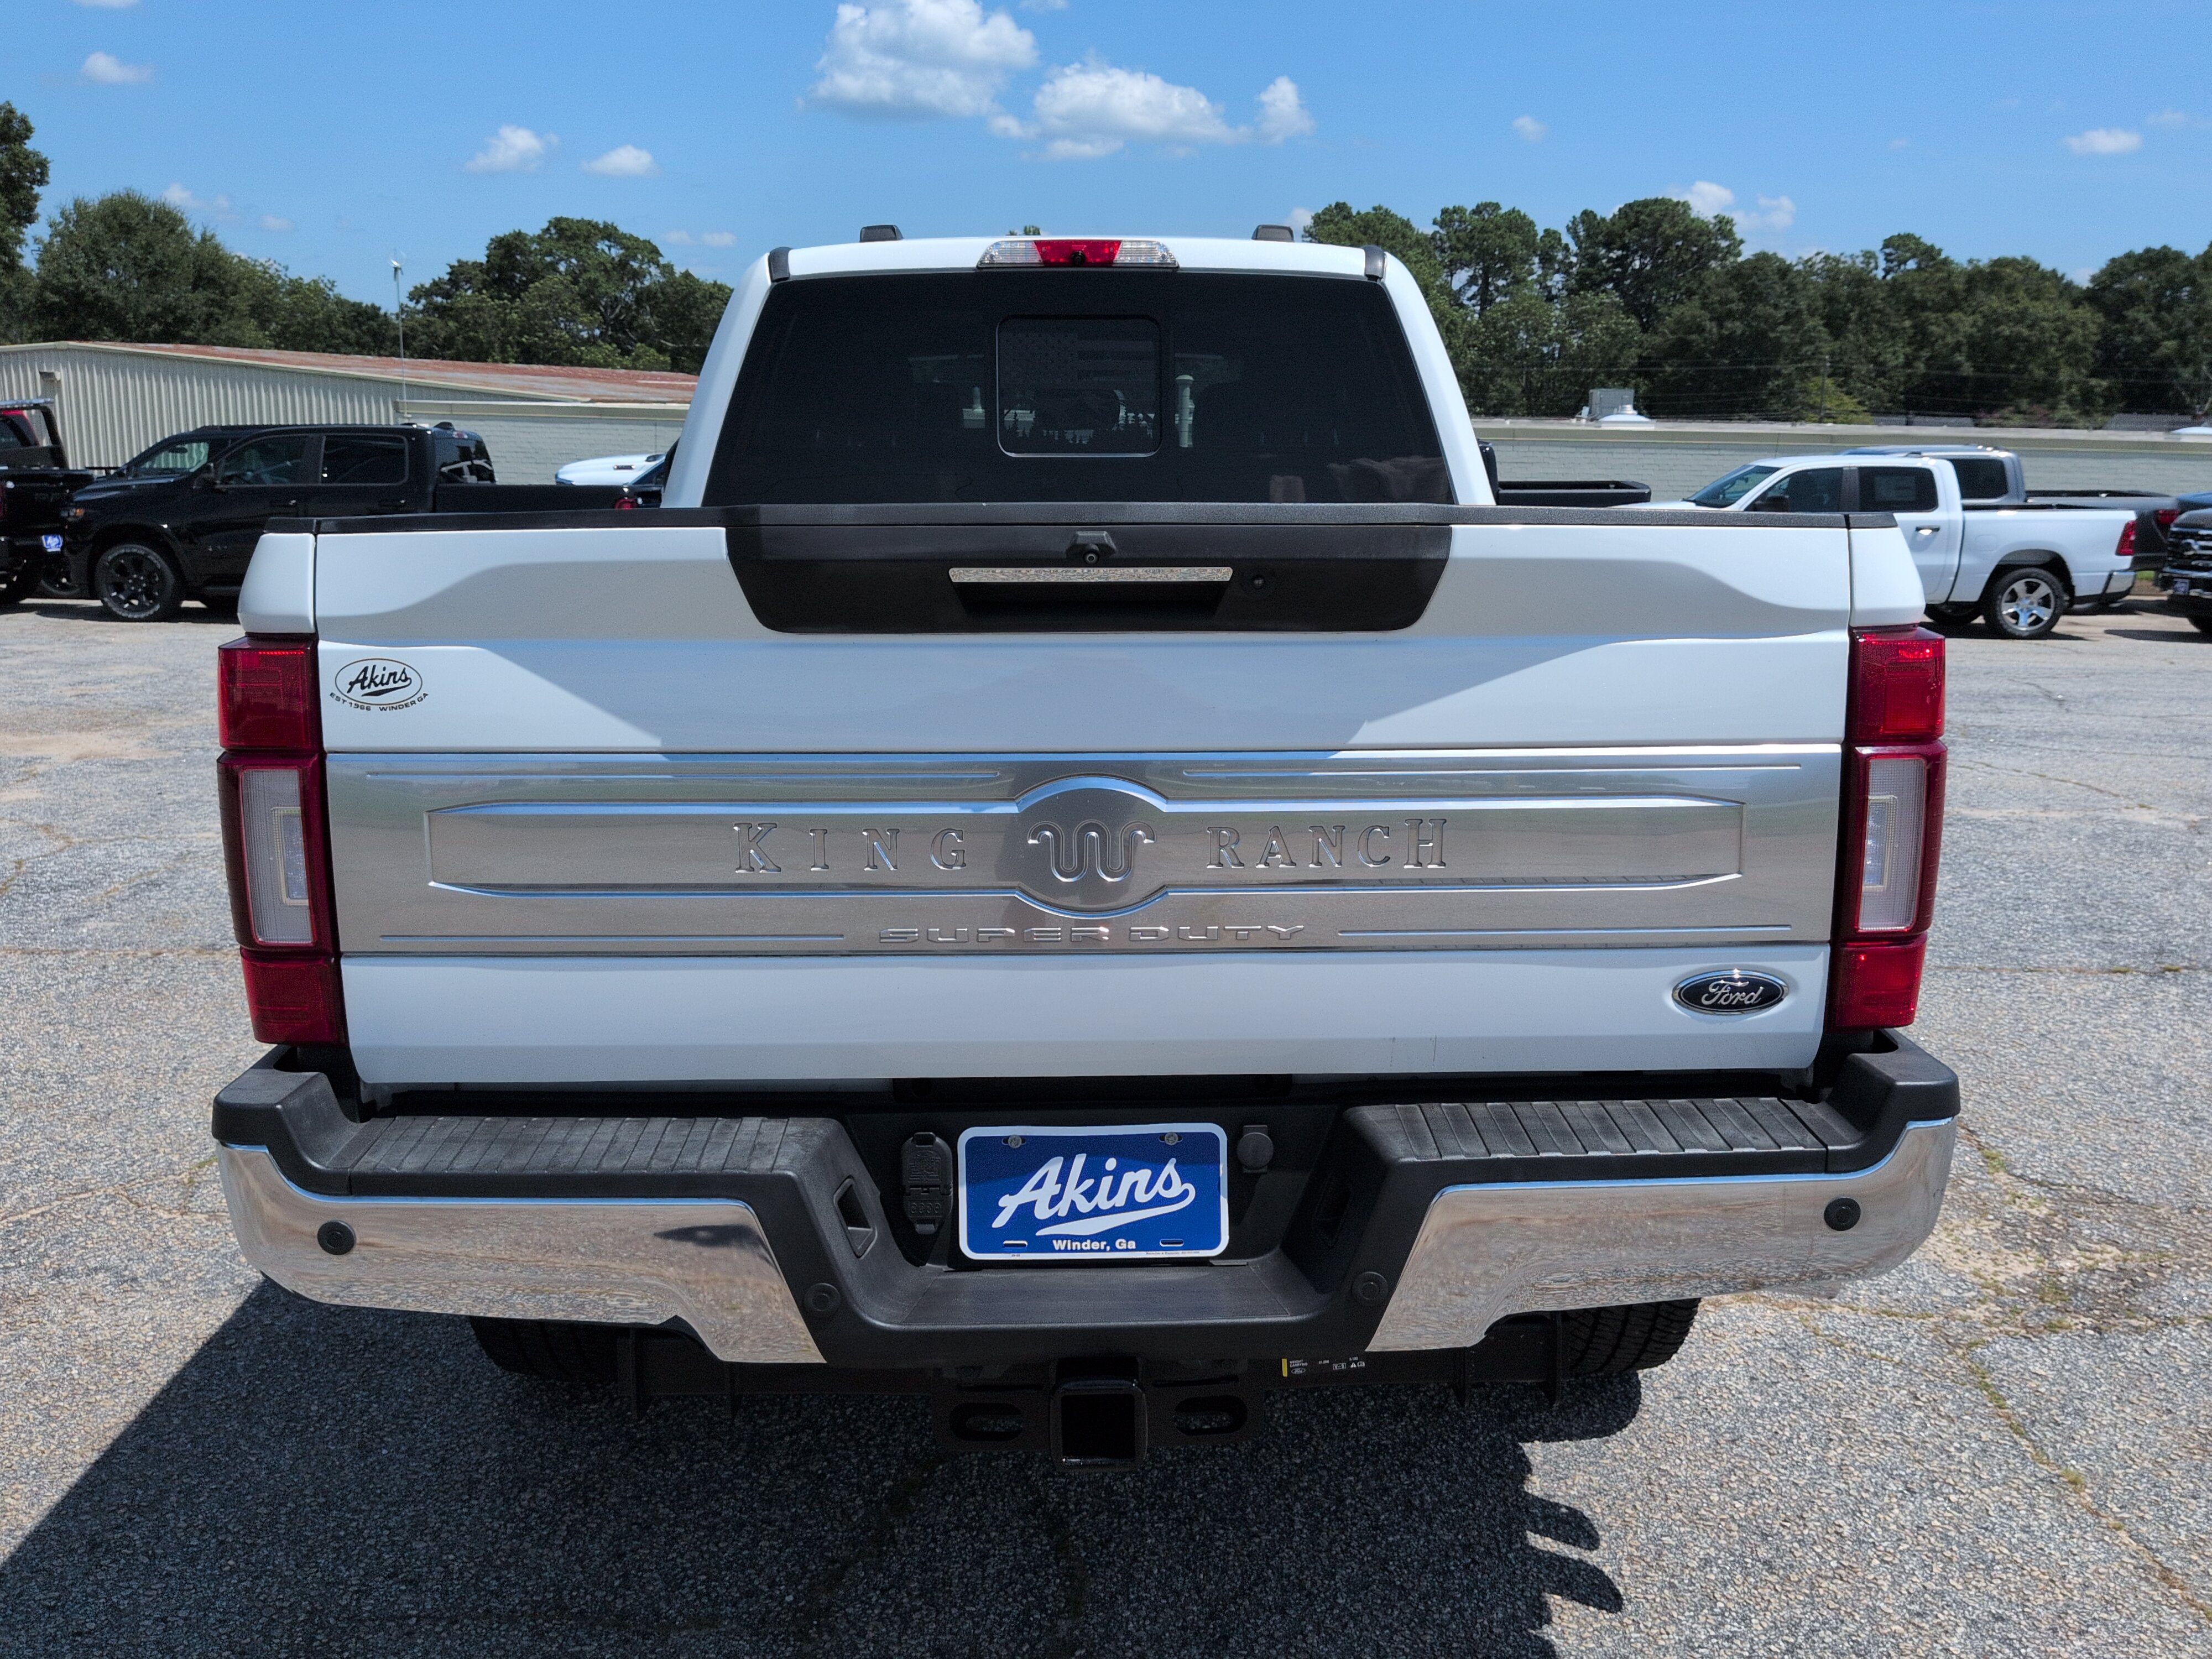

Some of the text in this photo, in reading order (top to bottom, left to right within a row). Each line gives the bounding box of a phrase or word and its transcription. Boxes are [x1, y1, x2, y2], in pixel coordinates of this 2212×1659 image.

[347, 664, 412, 697] Akins
[330, 692, 429, 712] EST 1966 WINDER GA
[733, 818, 1447, 873] KING RANCH
[879, 925, 1305, 943] SUPER DUTY
[1701, 980, 1764, 1005] Ford
[992, 1153, 1196, 1237] Akins
[1052, 1238, 1136, 1251] Winder, Ga
